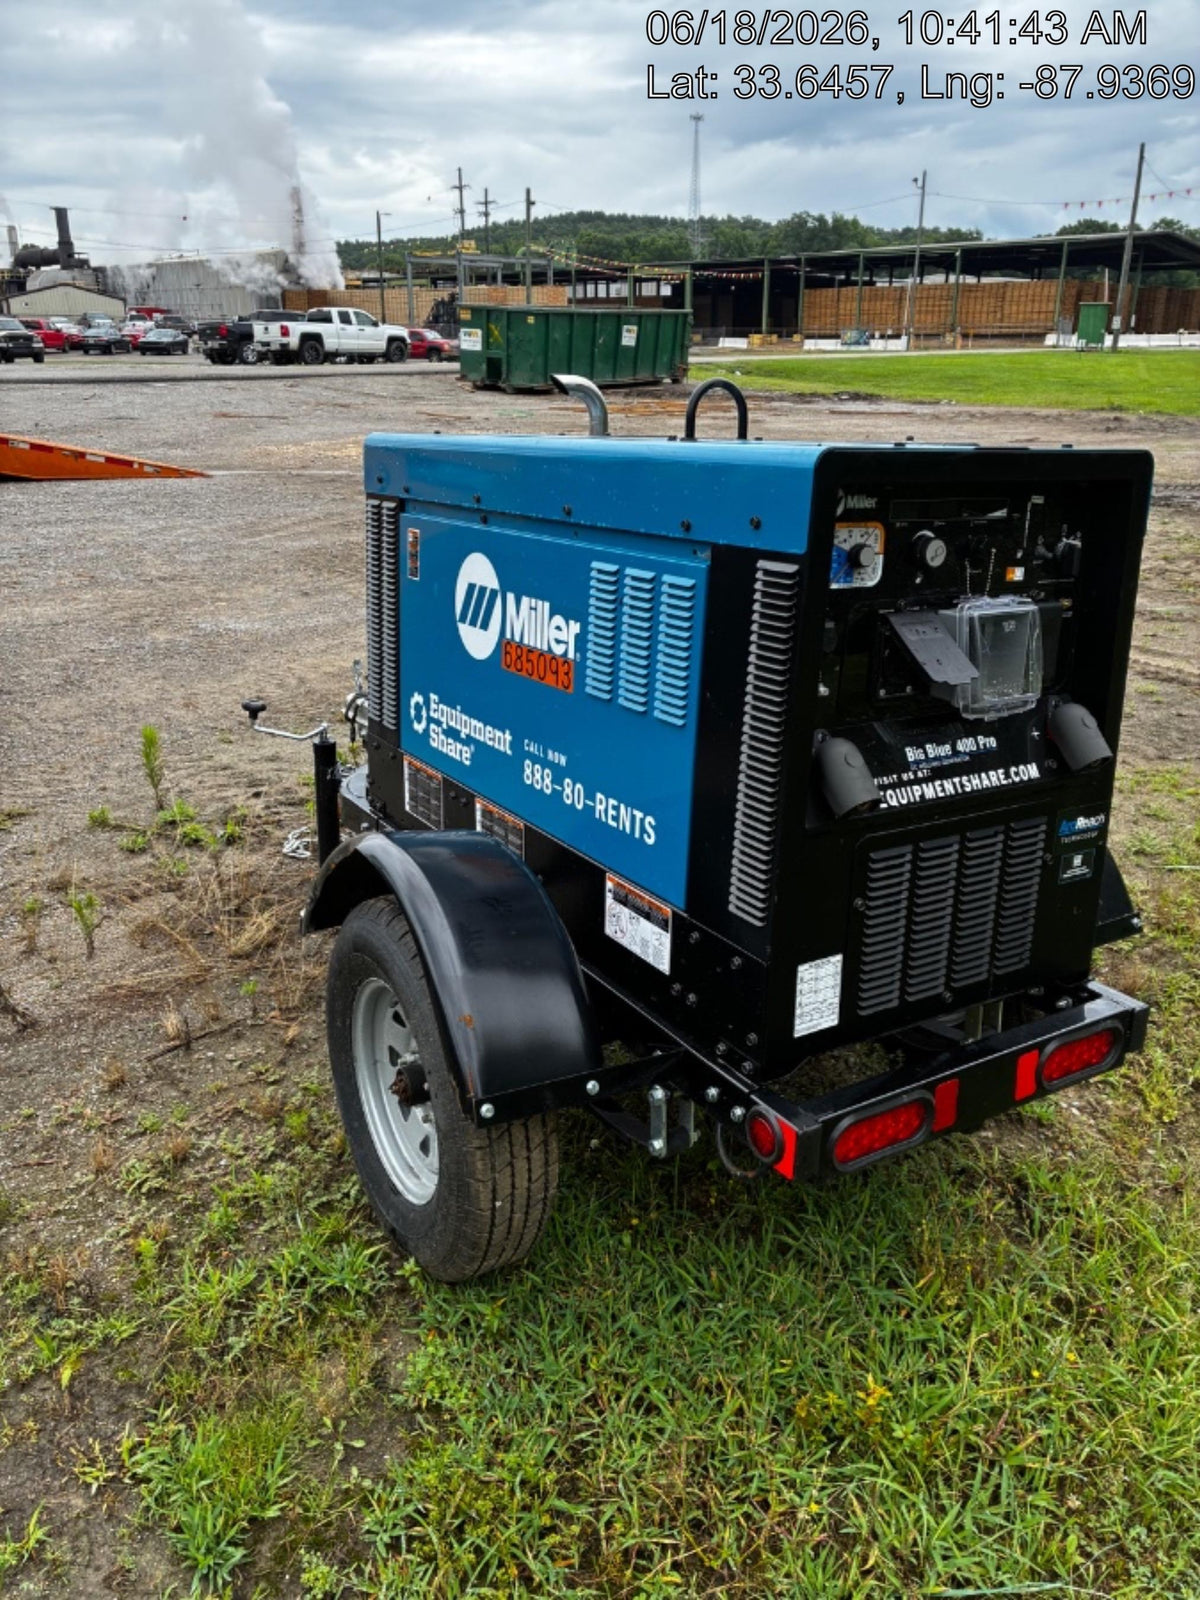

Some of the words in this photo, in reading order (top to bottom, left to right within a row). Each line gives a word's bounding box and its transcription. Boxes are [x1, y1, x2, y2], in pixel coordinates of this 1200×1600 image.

[846, 494, 877, 509] Miller
[506, 591, 580, 660] Miller
[503, 641, 573, 691] 685093
[429, 693, 513, 756] Equipment
[429, 724, 472, 766] Share
[524, 739, 545, 758] CALL
[547, 748, 567, 767] NOW
[905, 746, 925, 762] Big
[926, 742, 952, 758] Blue
[956, 737, 977, 753] 400
[977, 735, 997, 750] Pro
[523, 759, 657, 846] 888-80-RENTS
